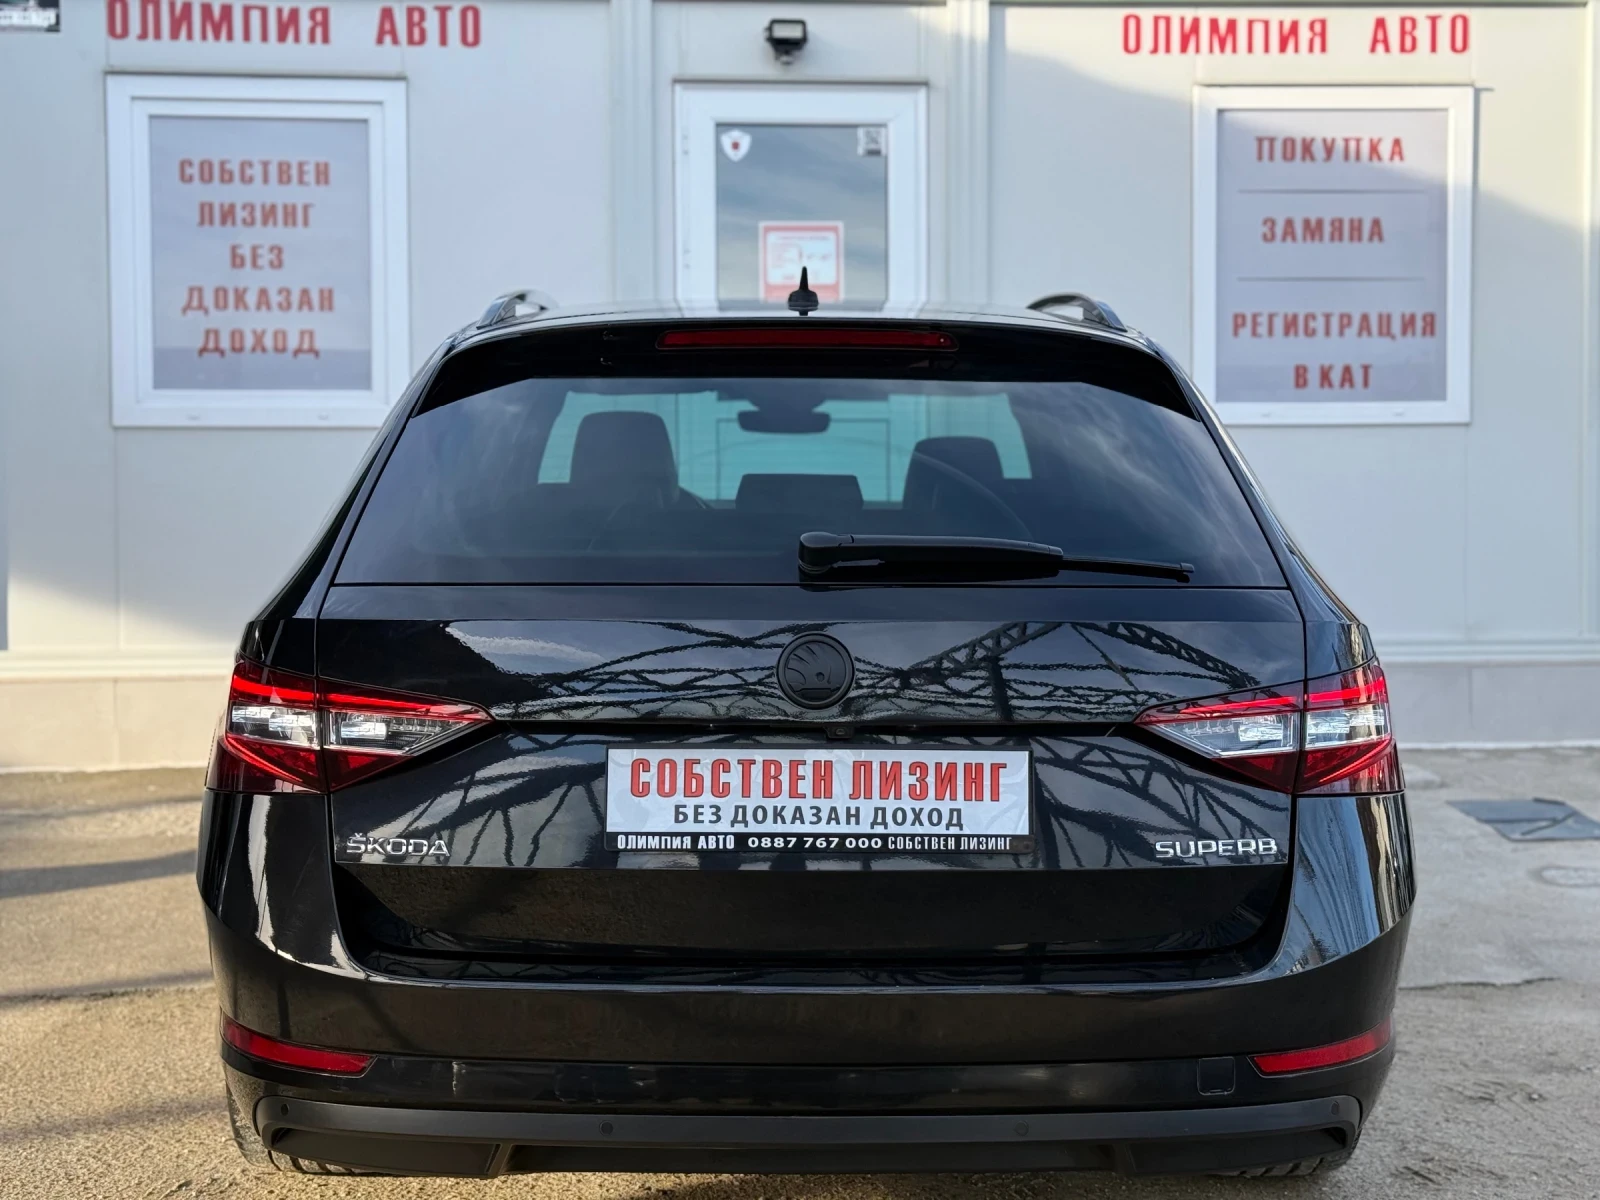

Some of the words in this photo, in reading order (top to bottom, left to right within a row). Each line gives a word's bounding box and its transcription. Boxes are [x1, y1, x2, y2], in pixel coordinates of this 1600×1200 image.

[107, 0, 331, 45] ОЛИМПИЯ
[375, 5, 482, 48] АВТО
[1123, 14, 1328, 54] ОЛИМПИЯ
[1369, 15, 1471, 54] АВТО
[1255, 137, 1405, 162] ПОКУПКА
[179, 159, 331, 186] СОБСТВЕН
[197, 203, 315, 228] ЛИЗИНГ
[1262, 217, 1384, 244] ЗАМЯНА
[230, 245, 284, 270] БЕЗ
[181, 287, 335, 316] ДОКАЗАН
[1232, 313, 1437, 341] РЕГИСТРАЦИЯ
[198, 329, 320, 358] ДОХОД
[1294, 365, 1308, 389] В
[1319, 365, 1373, 389] КАТ
[630, 758, 833, 799] СОБСТВЕН
[849, 761, 1007, 802] ЛИЗИНГ
[673, 804, 723, 825] БЕЗ
[730, 805, 861, 828] ДОКАЗАН
[870, 807, 964, 831] ДОХОД
[346, 832, 451, 857] ŠKODA
[617, 835, 691, 850] ОЛИМПИЯ
[698, 836, 735, 850] АВТО
[747, 838, 797, 849] 0887
[803, 838, 839, 849] 767
[845, 838, 882, 850] 000
[888, 837, 955, 850] СОБСТВЕН
[960, 837, 1012, 851] ЛИЗИНГ
[1155, 838, 1278, 858] SUPERB
